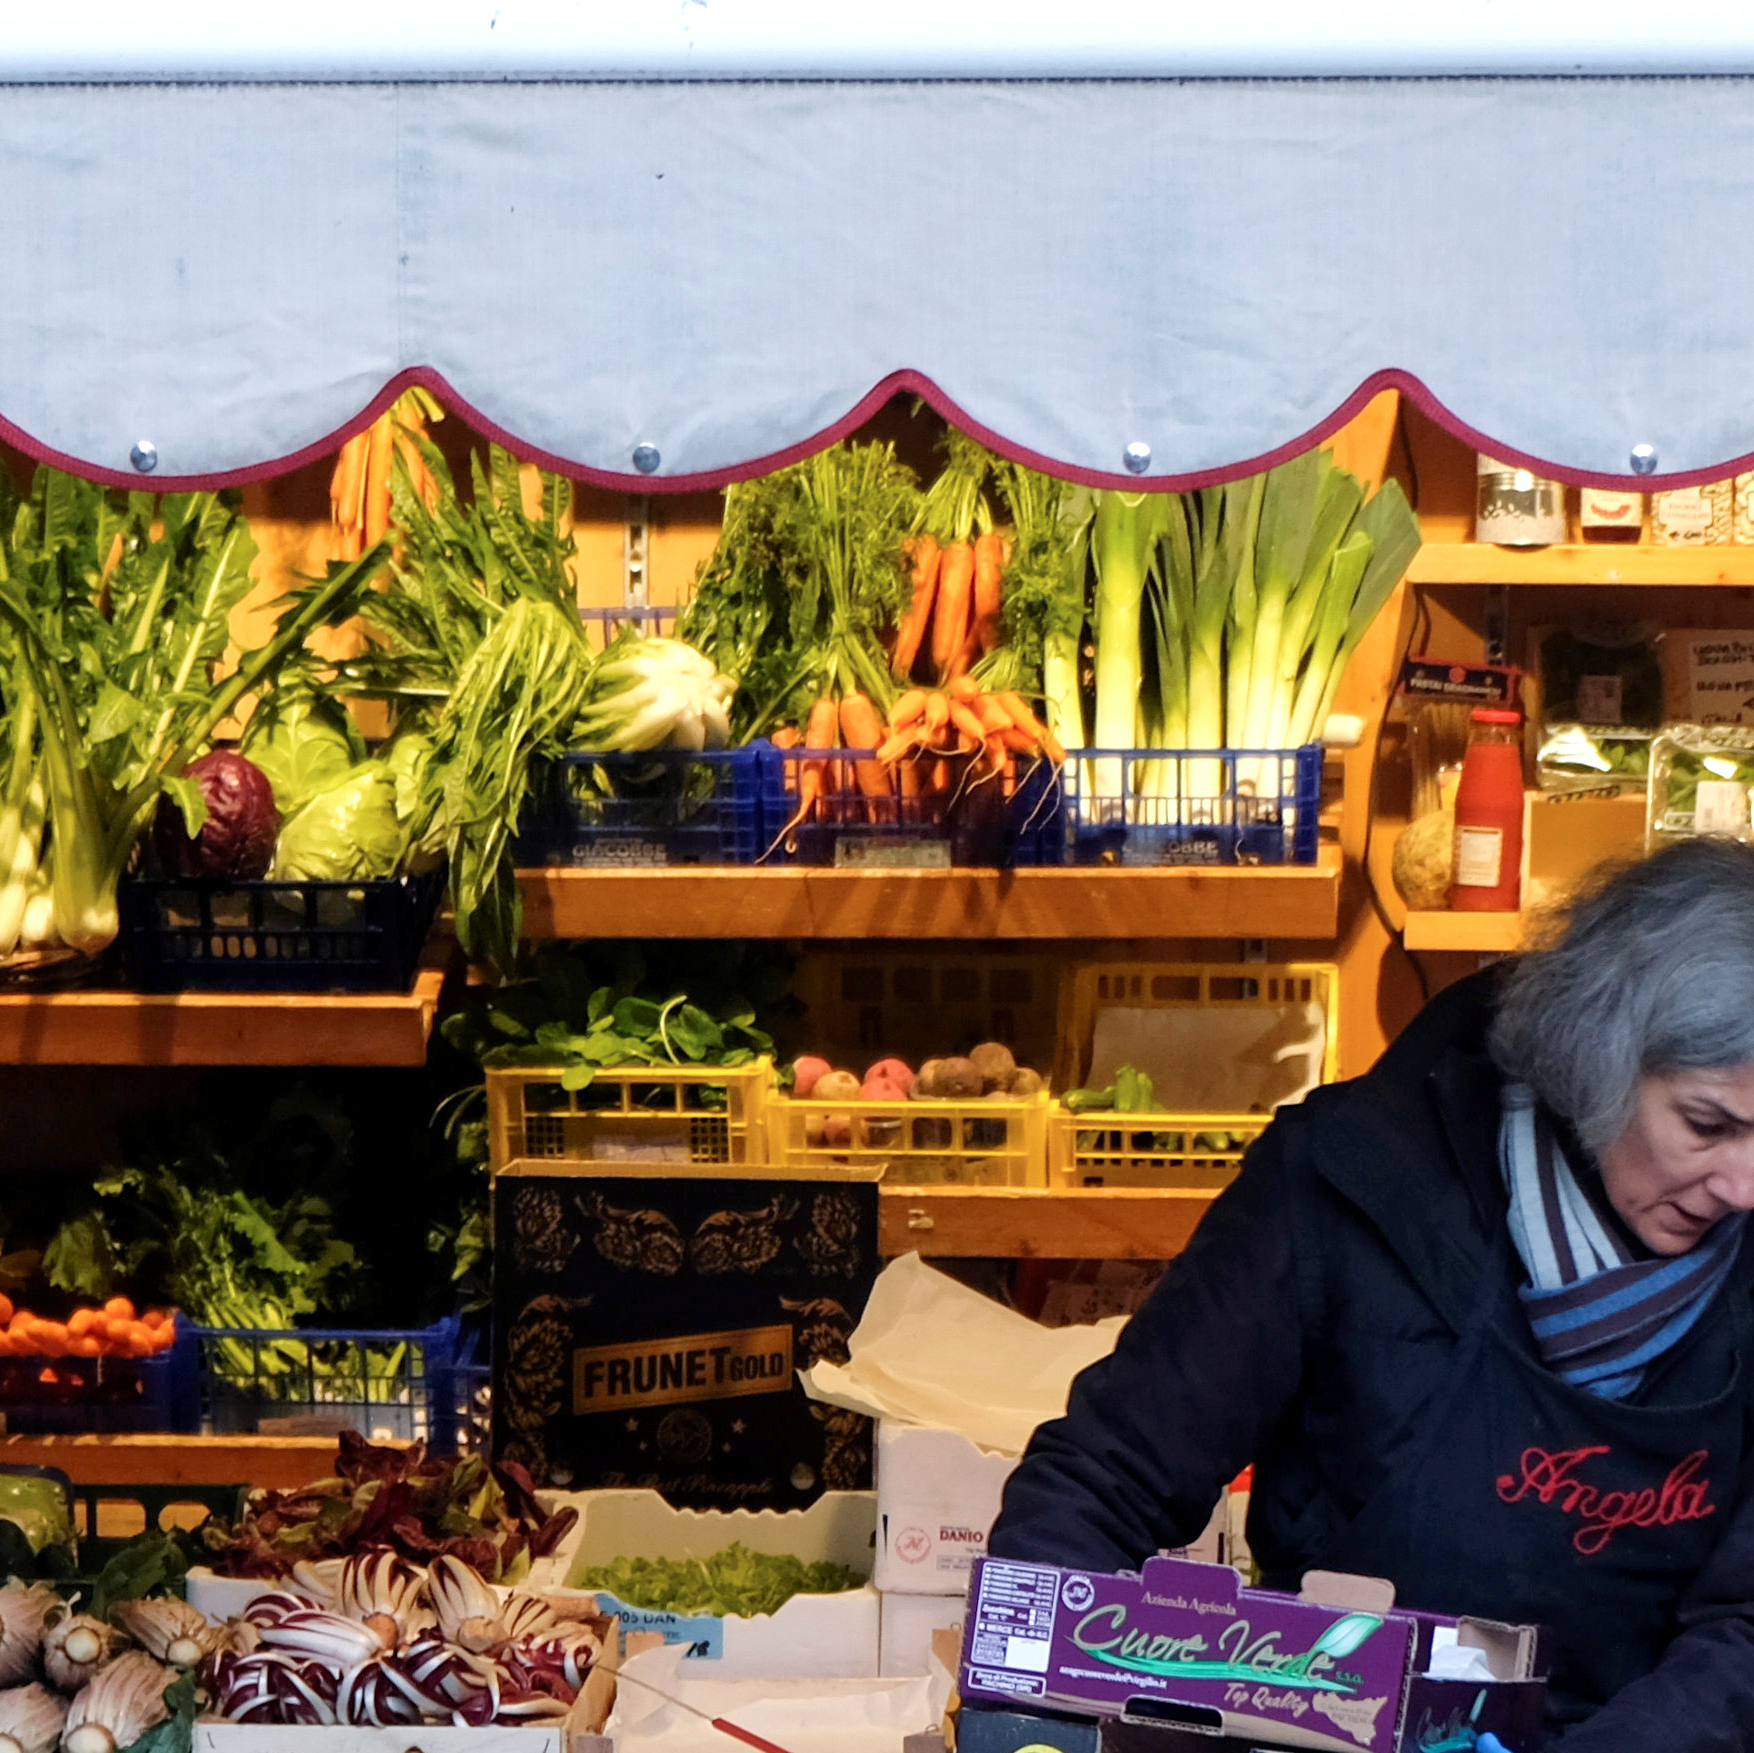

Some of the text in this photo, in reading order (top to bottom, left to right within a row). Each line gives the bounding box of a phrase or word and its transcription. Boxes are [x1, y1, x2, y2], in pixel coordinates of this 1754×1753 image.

[583, 1346, 784, 1399] FRUNET GOLD
[1495, 1444, 1717, 1555] Angela
[939, 1529, 984, 1543] DANIO
[1142, 1591, 1237, 1616] Azienda Agricola
[1072, 1603, 1209, 1664] Cuore
[1218, 1619, 1337, 1681] Verde
[1223, 1682, 1250, 1709] Top
[1250, 1686, 1309, 1717] Quality
